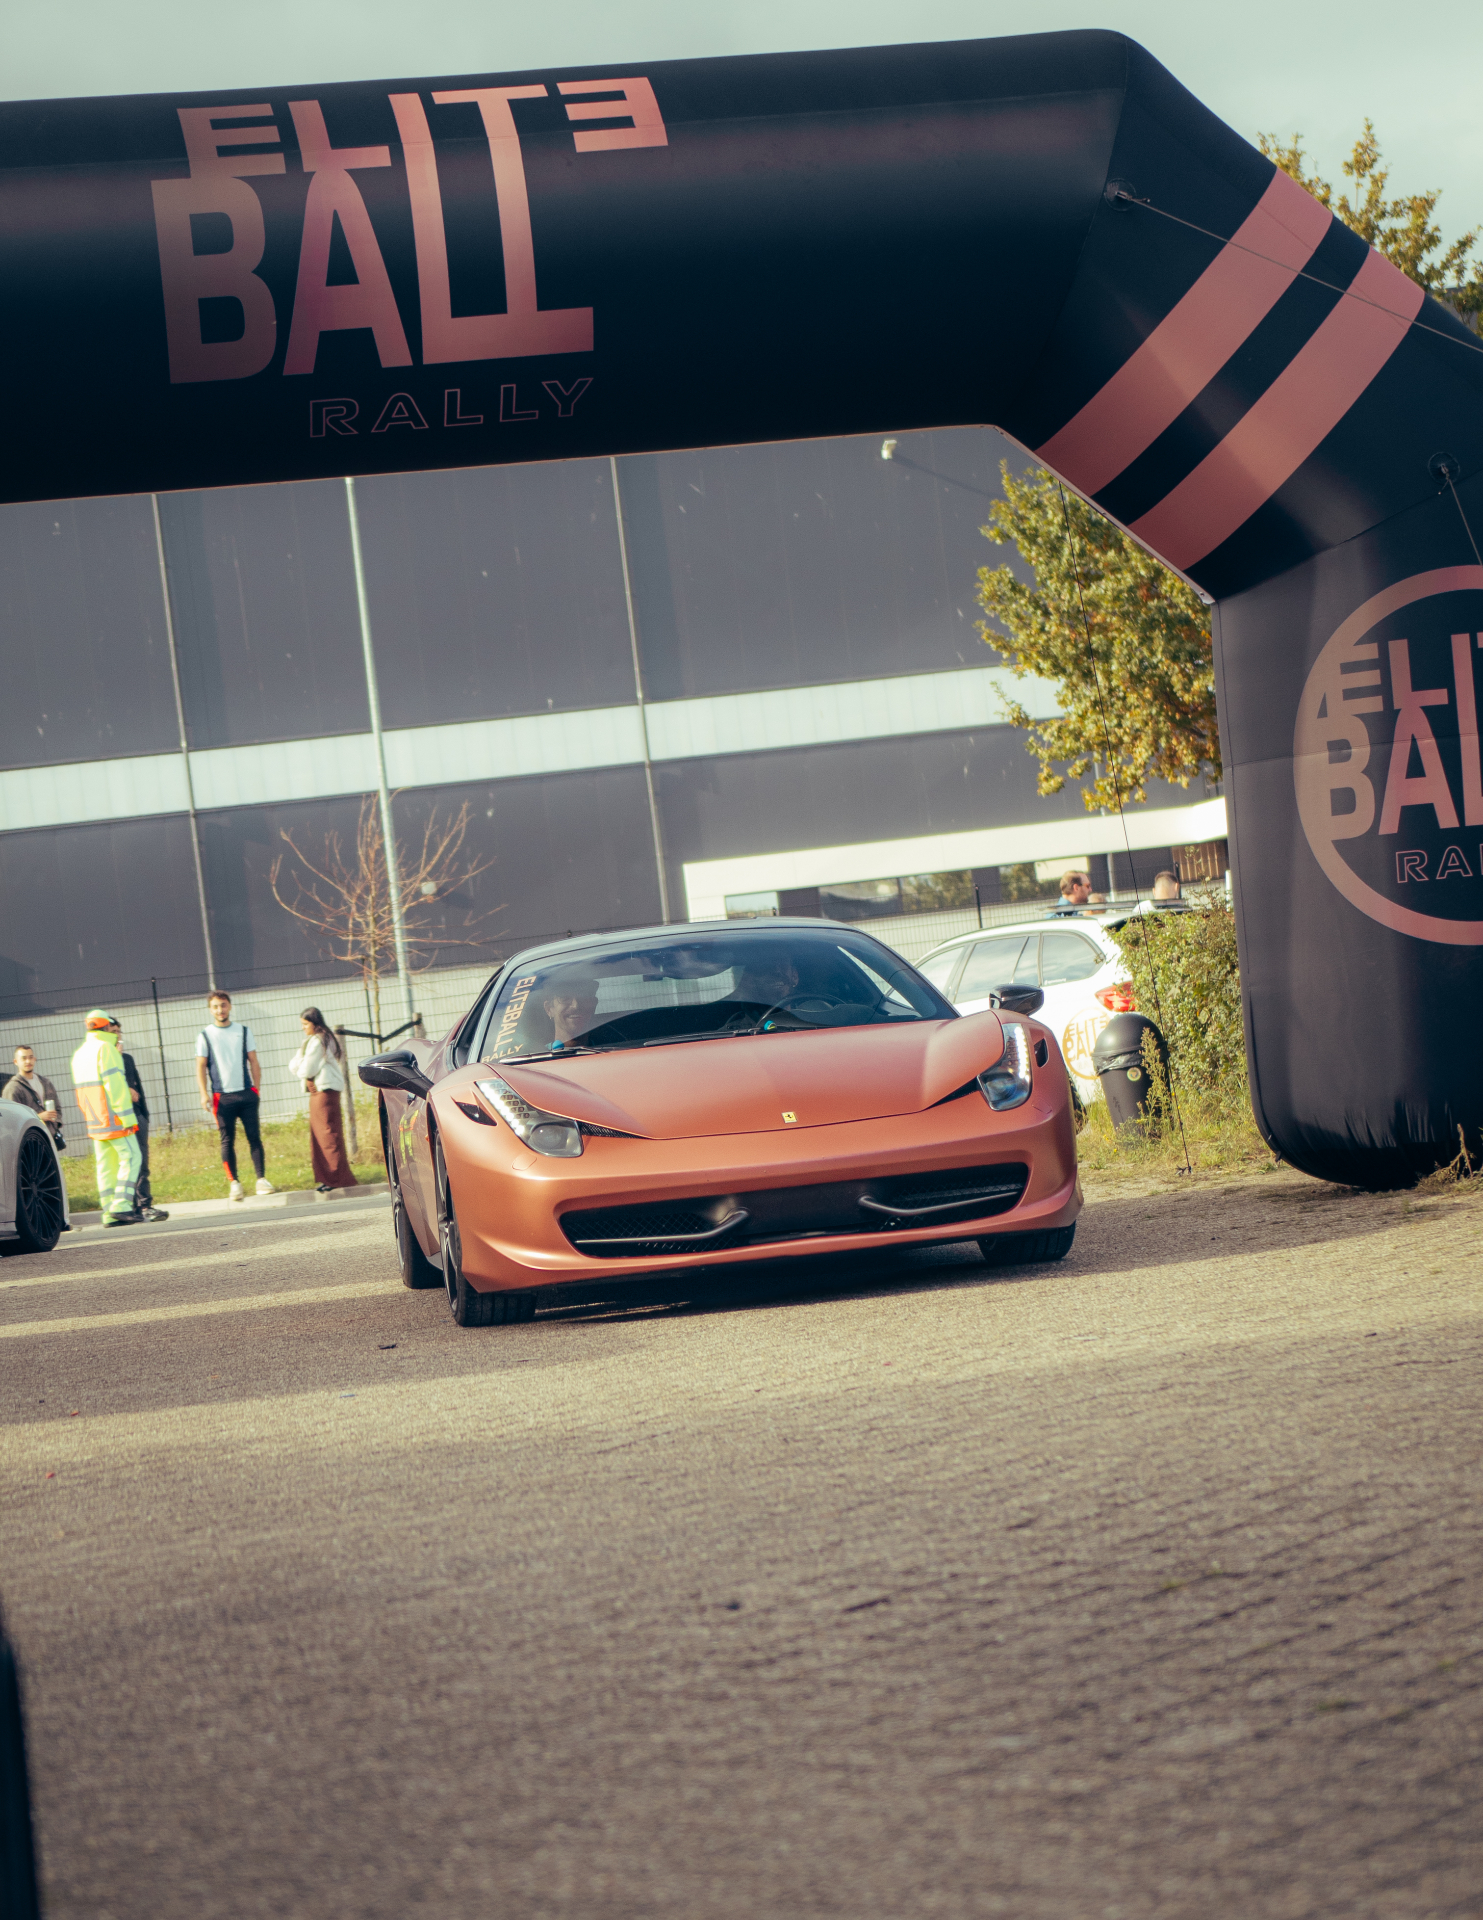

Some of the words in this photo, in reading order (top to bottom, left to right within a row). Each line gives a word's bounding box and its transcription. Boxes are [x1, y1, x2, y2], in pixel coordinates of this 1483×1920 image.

[309, 377, 594, 438] RALLY
[1332, 632, 1483, 716] ELI
[1395, 843, 1483, 884] RA
[481, 1043, 524, 1063] RALLY
